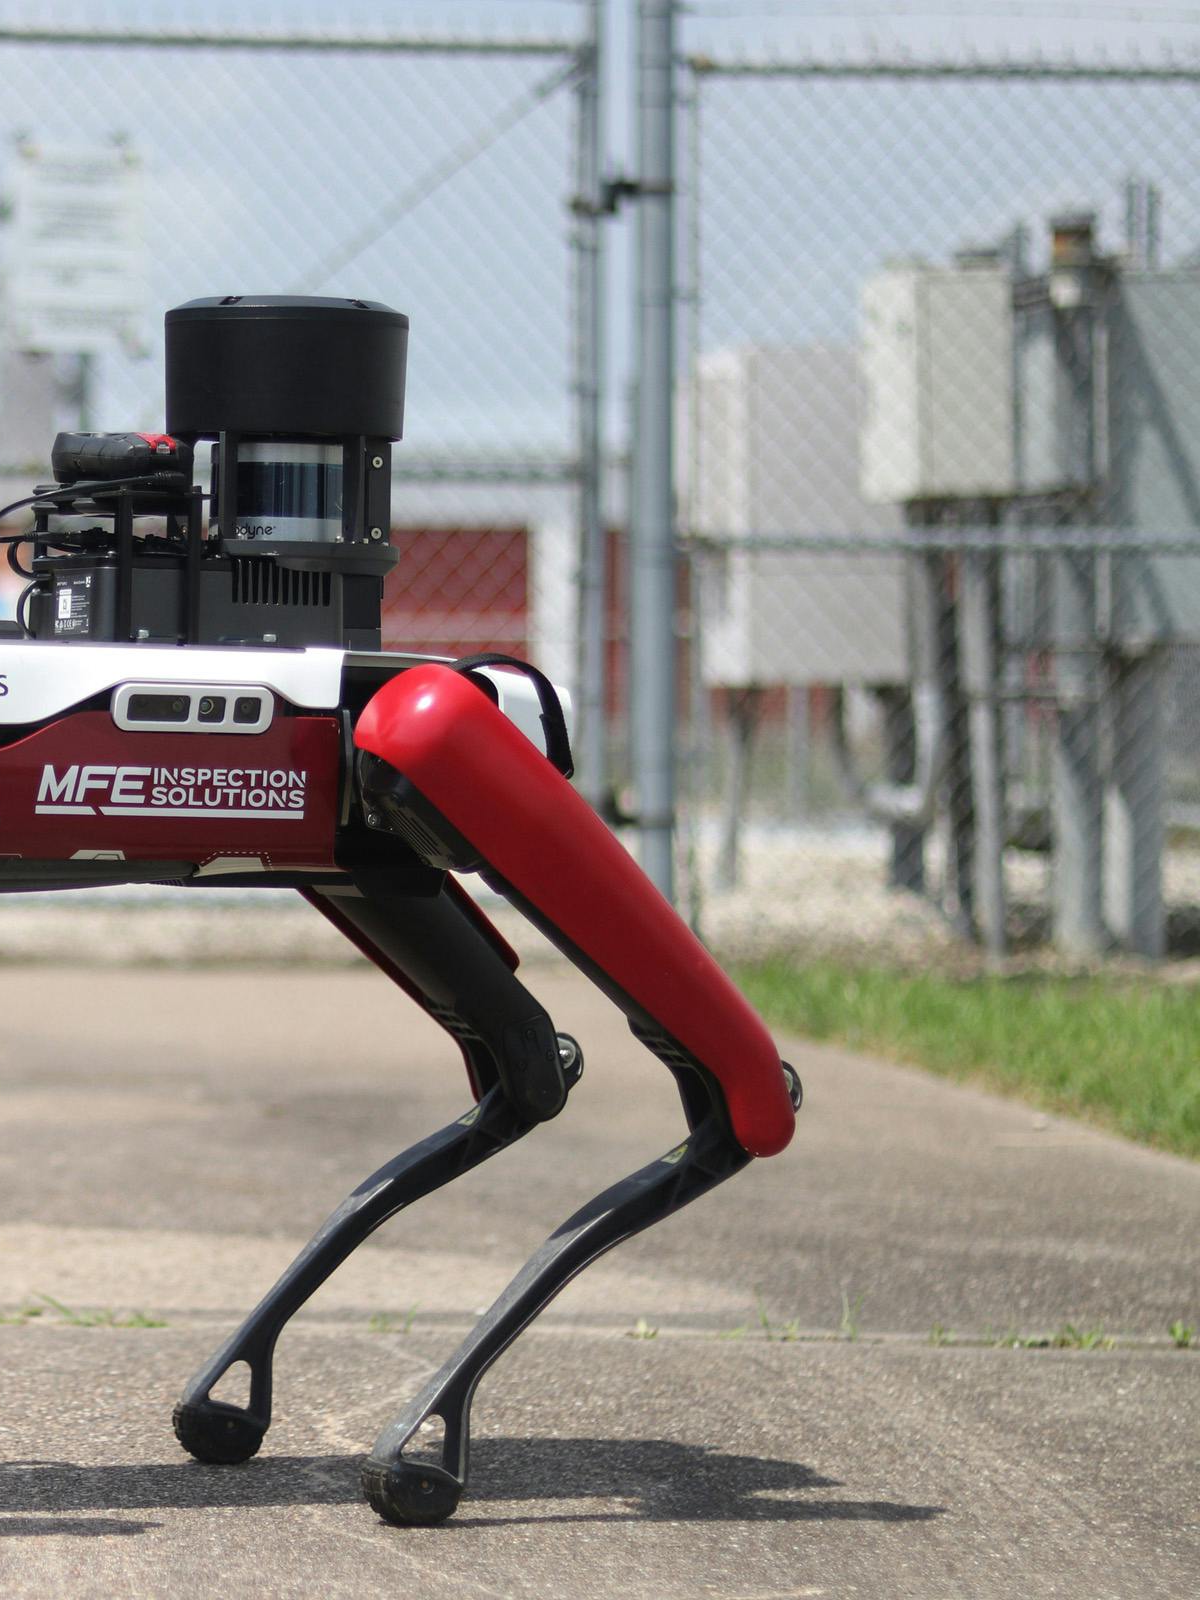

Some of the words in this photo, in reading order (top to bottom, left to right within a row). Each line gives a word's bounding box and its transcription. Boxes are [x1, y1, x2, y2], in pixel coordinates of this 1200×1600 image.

[37, 764, 152, 804] MFE
[153, 767, 306, 788] INSPECTION
[150, 787, 305, 808] SOLUTIONS
